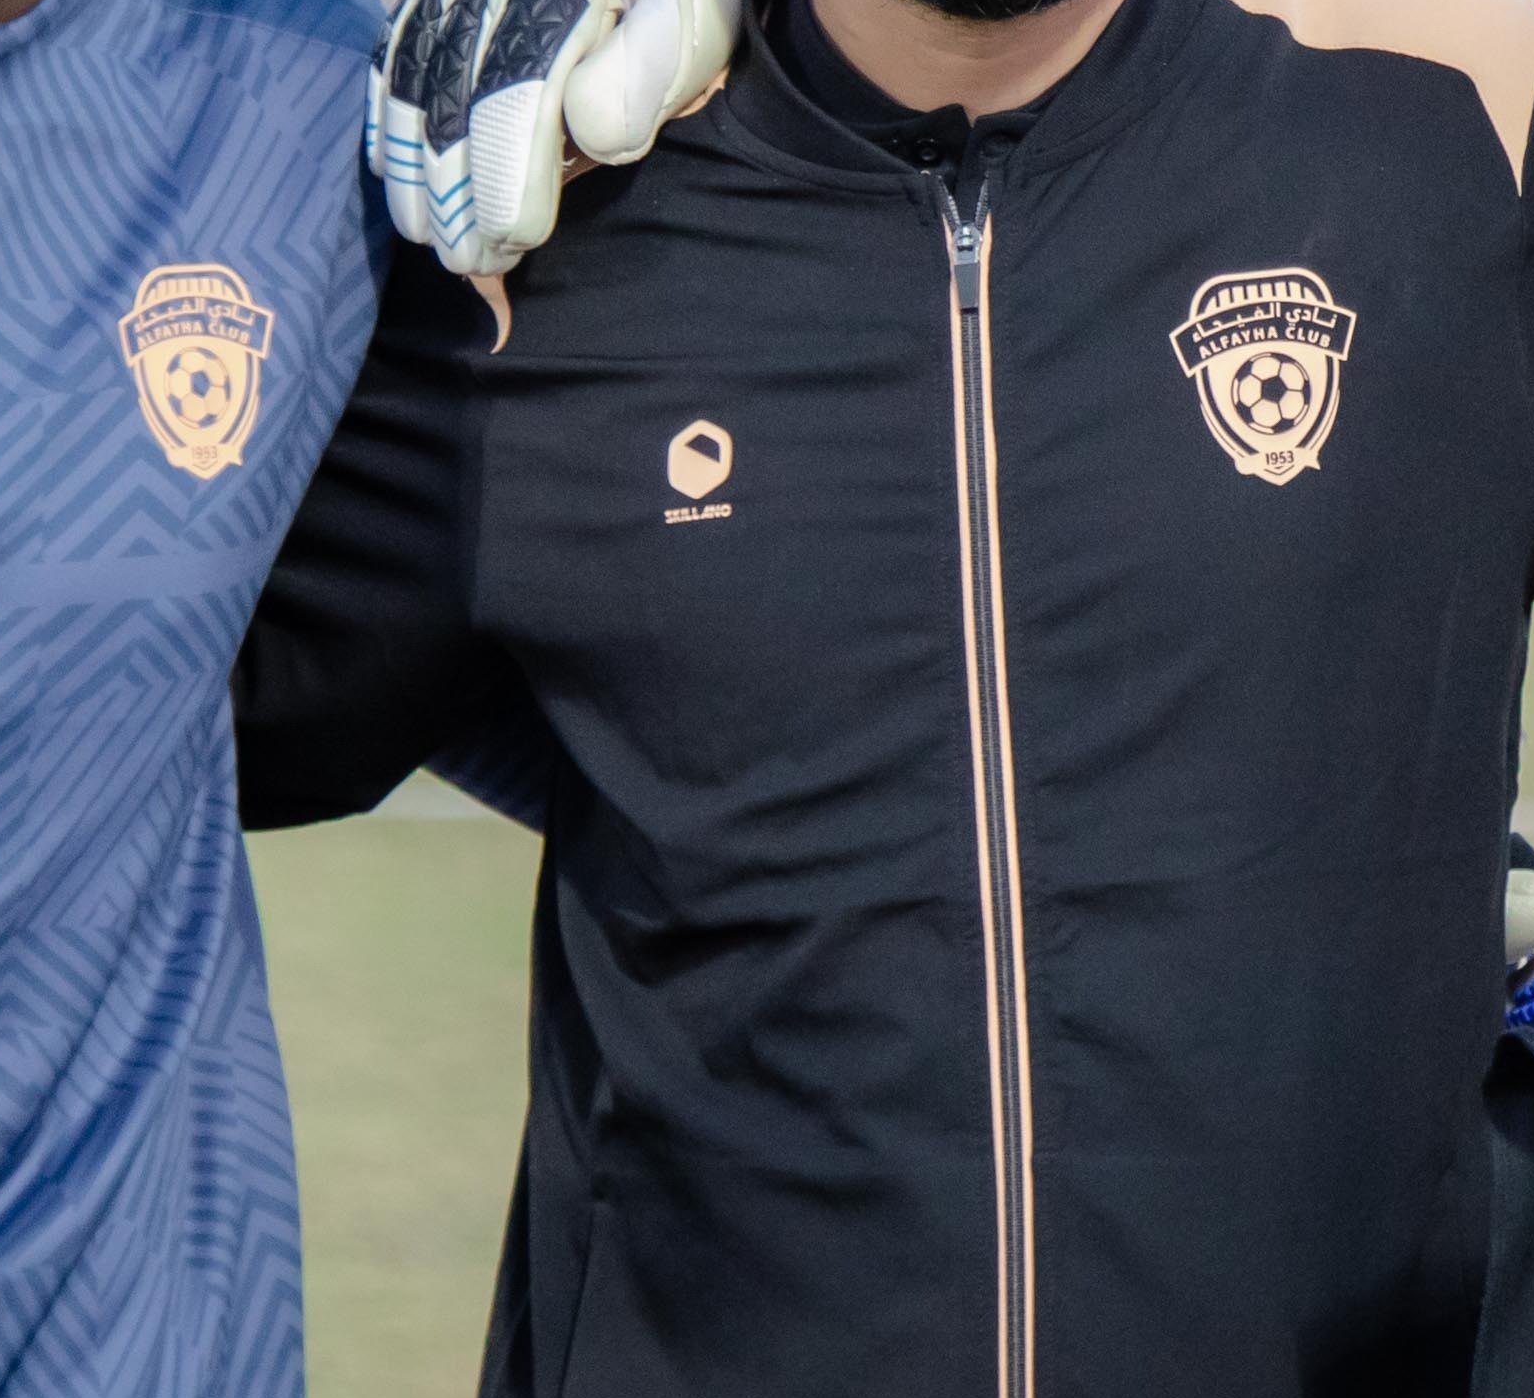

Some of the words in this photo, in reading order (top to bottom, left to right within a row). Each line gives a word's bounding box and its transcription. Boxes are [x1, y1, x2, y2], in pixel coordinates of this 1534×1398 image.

[1285, 306, 1338, 328] نادي
[207, 321, 251, 344] CLUB
[1198, 325, 1278, 359] ALFAYHA
[1284, 326, 1332, 348] CLUB
[1265, 450, 1295, 465] 1953
